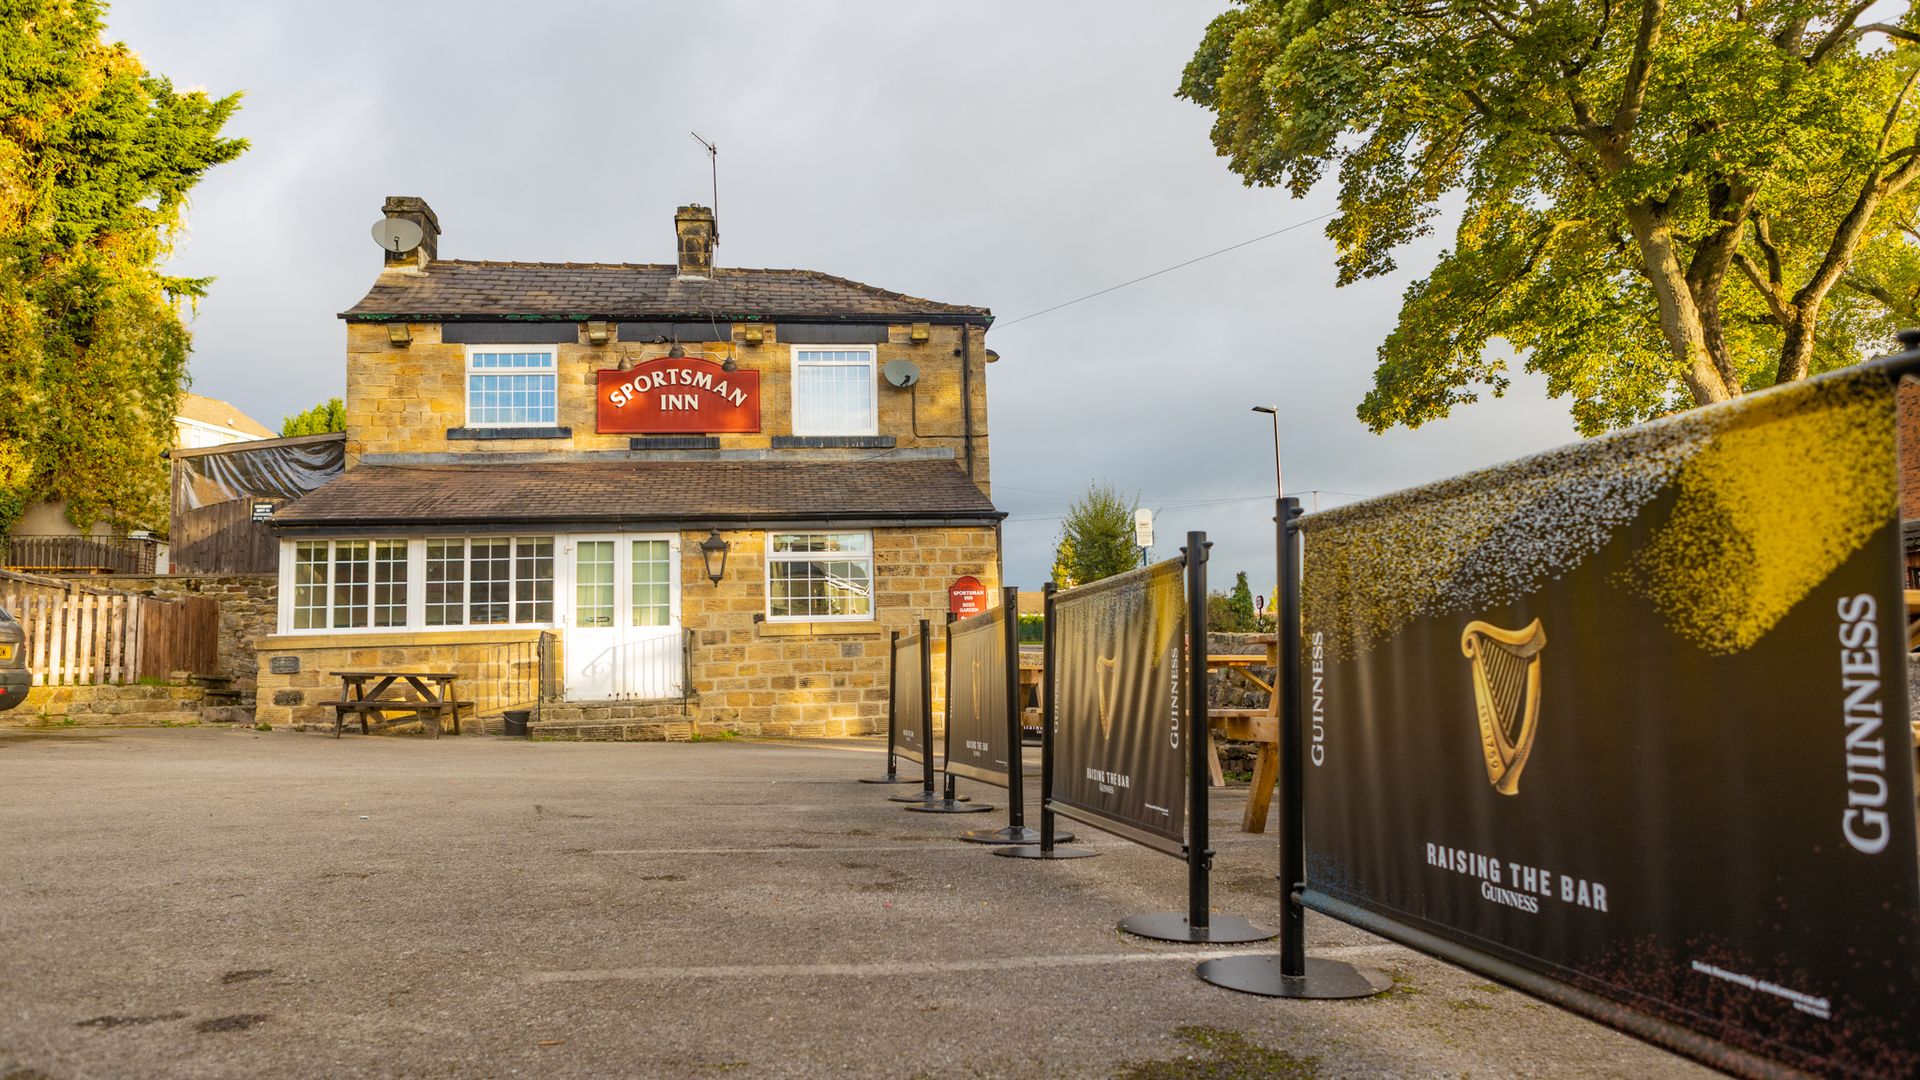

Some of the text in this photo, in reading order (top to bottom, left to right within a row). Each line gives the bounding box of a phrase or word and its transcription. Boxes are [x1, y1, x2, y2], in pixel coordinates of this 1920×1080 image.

[609, 368, 748, 408] SPORTSMAN
[661, 394, 698, 410] INN
[1169, 647, 1179, 749] GUINNESS
[1311, 631, 1324, 767] GUINNESS
[1837, 593, 1890, 854] GUINNESS
[1106, 771, 1117, 786] THE
[1426, 842, 1608, 913] RAISING THE BAR
[1481, 881, 1539, 914] GUINNESS
